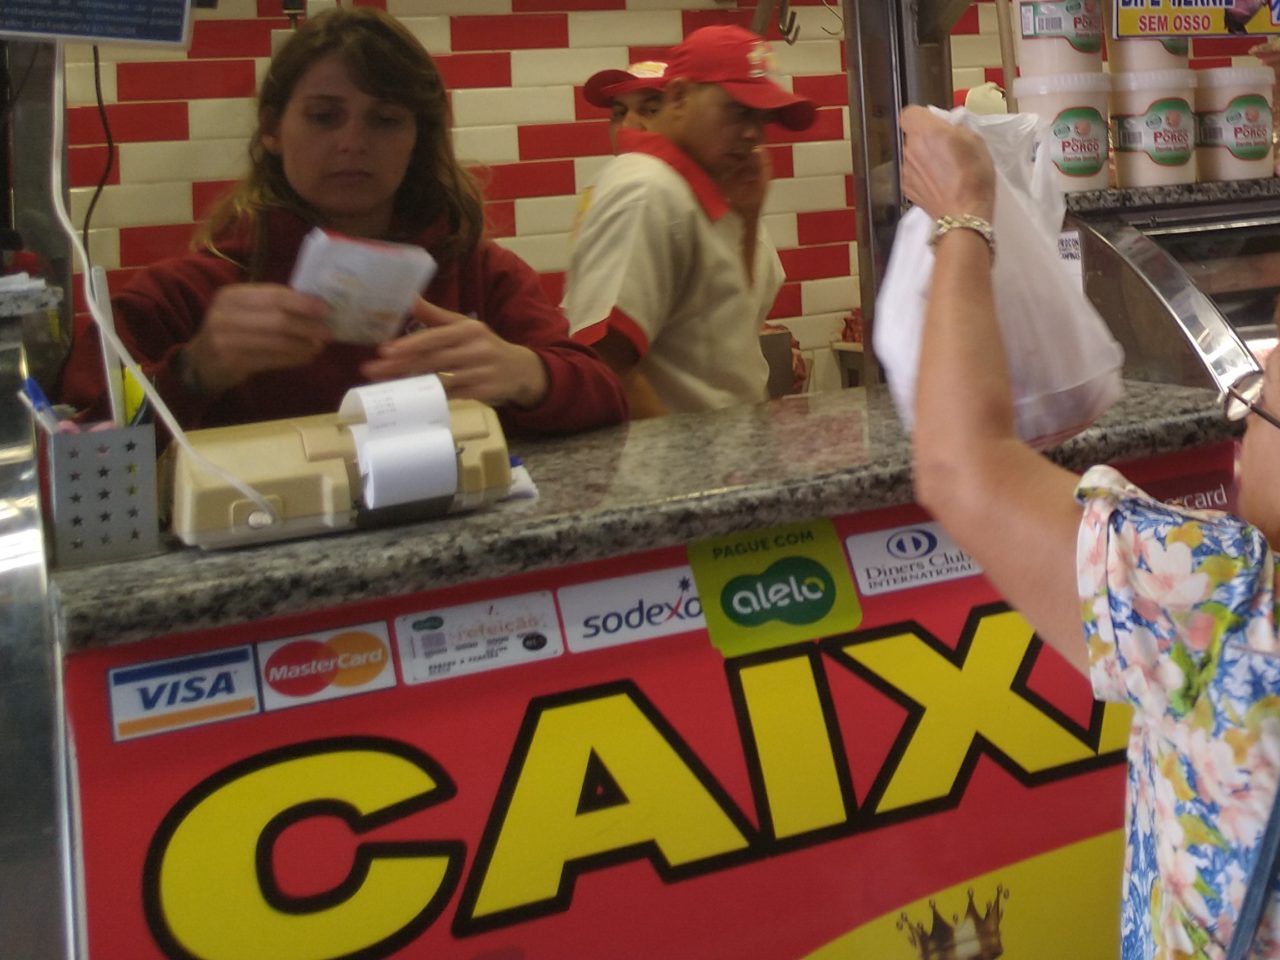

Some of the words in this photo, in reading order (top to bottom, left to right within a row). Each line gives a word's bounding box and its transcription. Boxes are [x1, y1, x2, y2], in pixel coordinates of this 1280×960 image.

[1139, 15, 1169, 32] SEM
[1173, 14, 1211, 31] OSSO
[712, 540, 770, 560] PAGUE
[774, 530, 816, 548] COM
[865, 560, 925, 581] Diners
[929, 547, 972, 568] Club
[868, 562, 974, 590] INTERNATIONAL
[732, 575, 825, 615] alelo
[582, 595, 704, 639] sodexo
[268, 648, 383, 683] MasterCard
[137, 670, 237, 712] VISA
[142, 601, 1134, 960] CAIX
